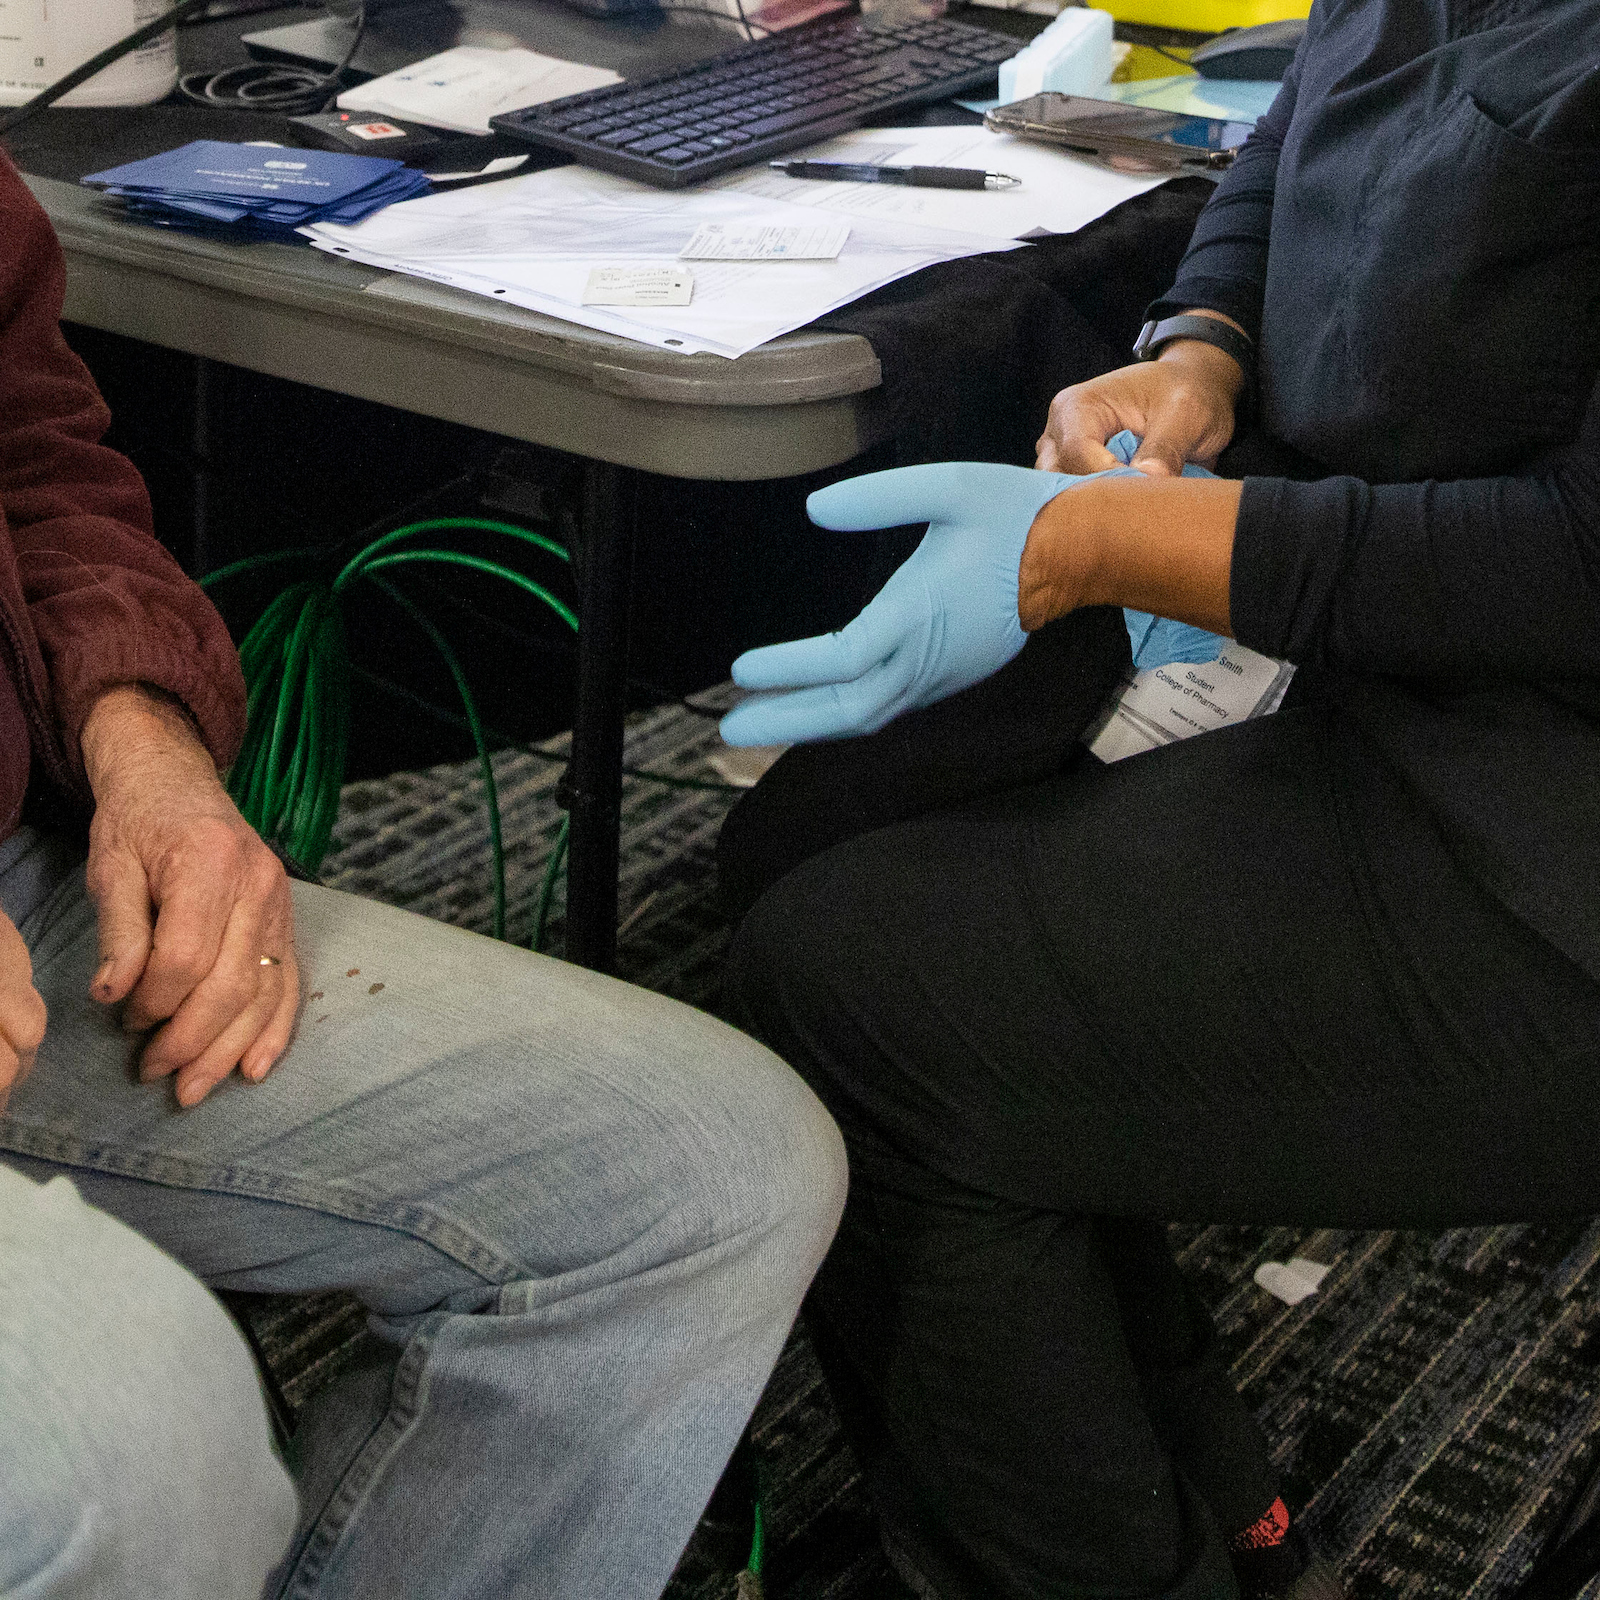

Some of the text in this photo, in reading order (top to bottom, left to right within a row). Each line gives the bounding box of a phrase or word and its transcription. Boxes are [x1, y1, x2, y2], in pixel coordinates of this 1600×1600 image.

[1219, 656, 1243, 676] Smith
[1185, 671, 1215, 693] Student
[1155, 669, 1183, 691] College
[1183, 687, 1193, 696] of
[1192, 691, 1229, 719] Pharmacy
